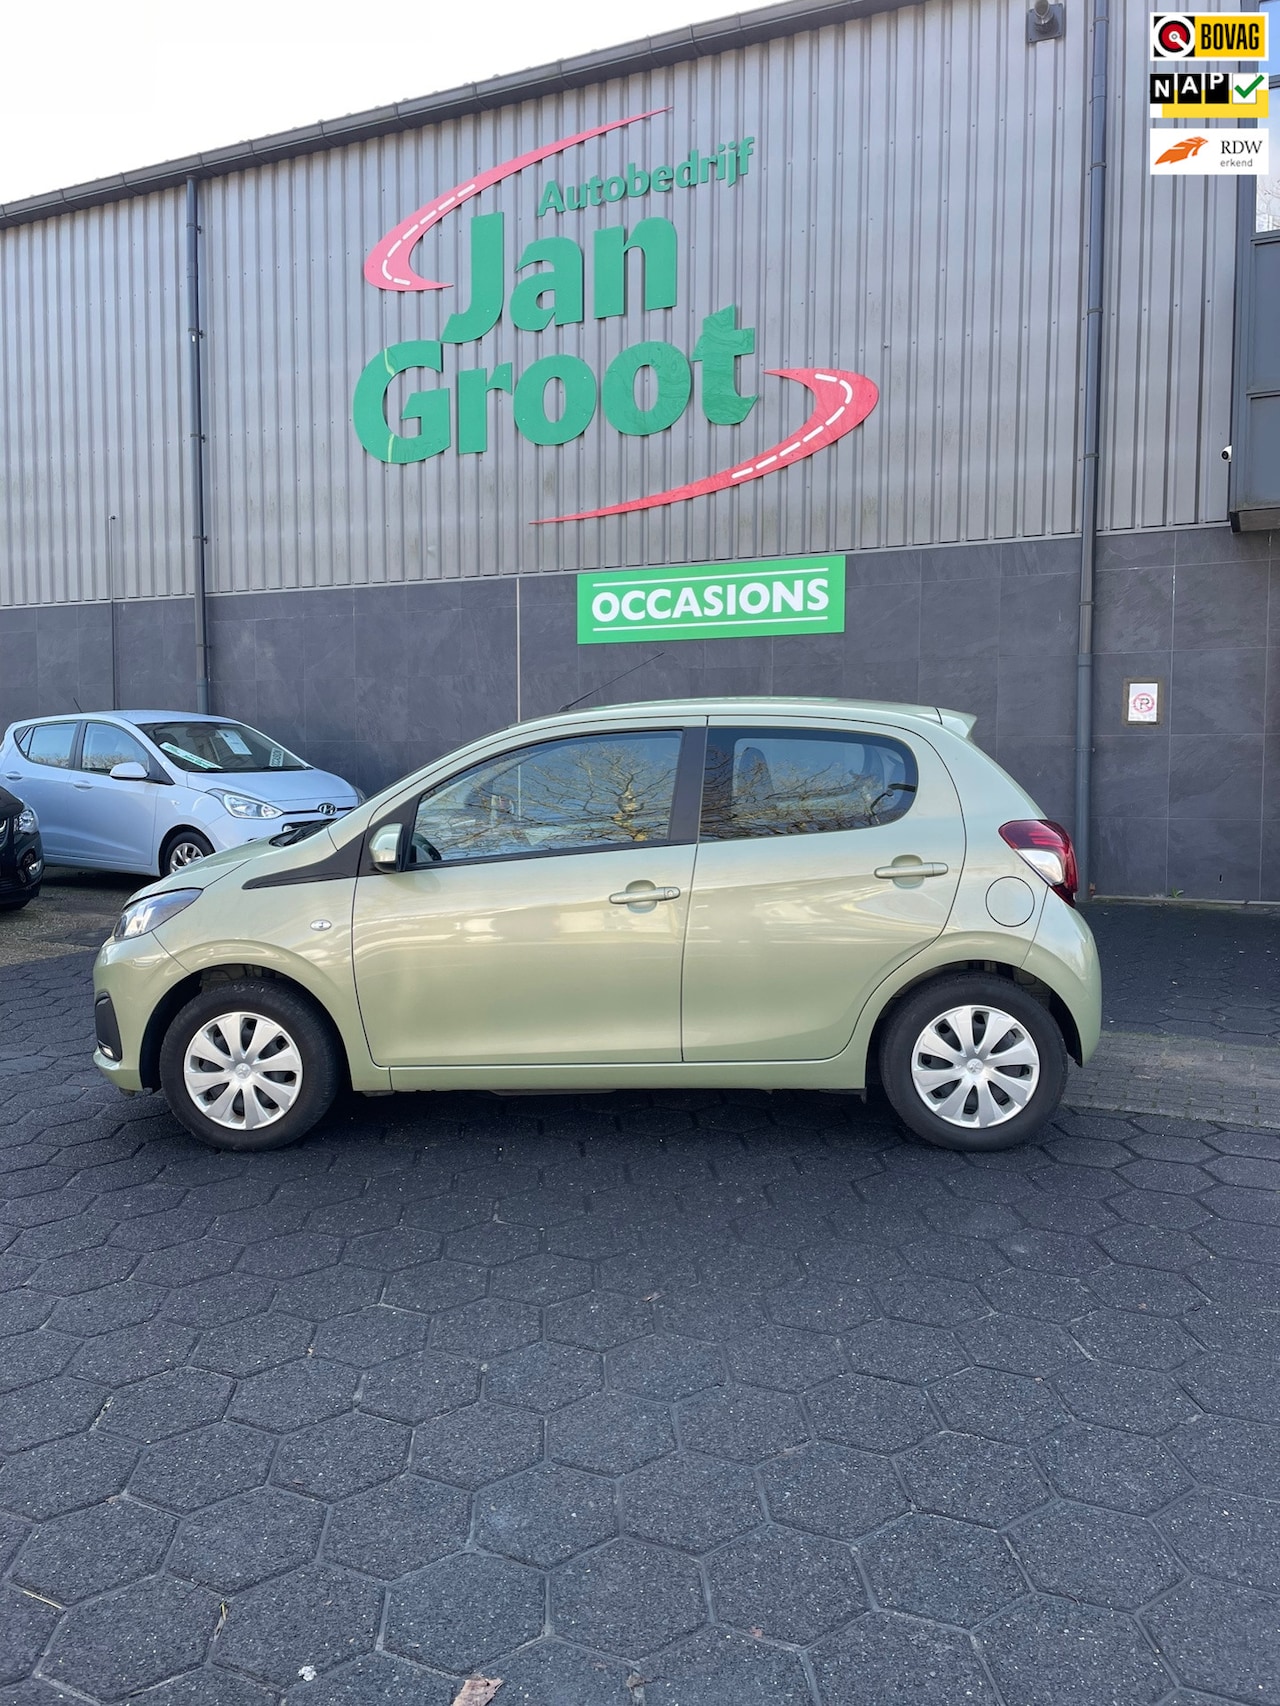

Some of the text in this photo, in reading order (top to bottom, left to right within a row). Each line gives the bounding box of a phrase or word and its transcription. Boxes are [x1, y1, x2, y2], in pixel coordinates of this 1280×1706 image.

[537, 136, 756, 217] Autobedrijf
[440, 211, 678, 343] Jan
[352, 304, 760, 465] Groot
[591, 578, 830, 623] OCCASIONS
